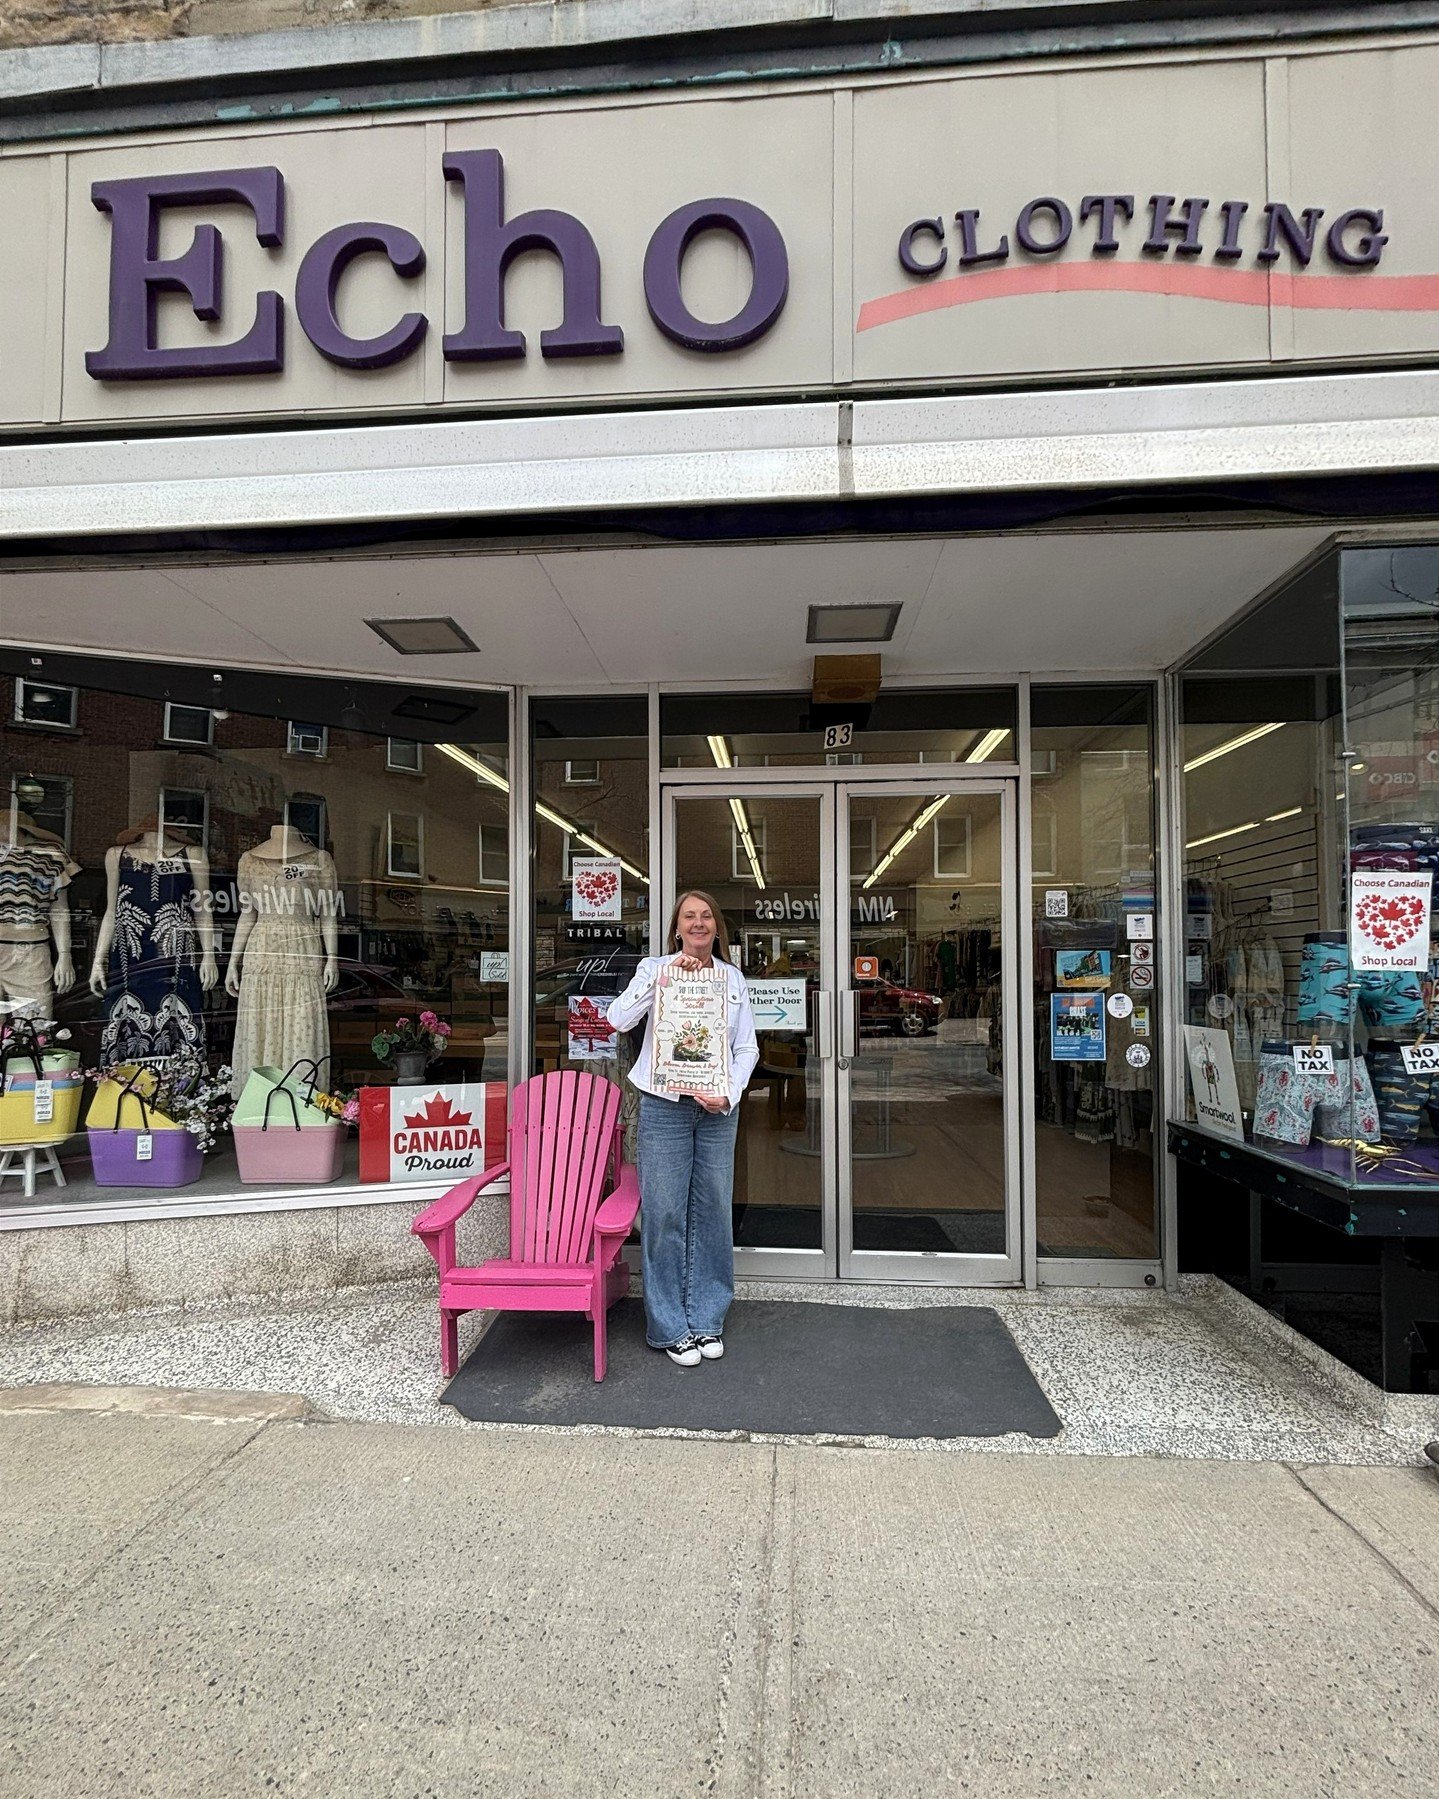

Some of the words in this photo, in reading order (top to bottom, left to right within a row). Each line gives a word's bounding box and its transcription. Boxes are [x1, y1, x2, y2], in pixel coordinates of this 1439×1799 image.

[897, 194, 1390, 277] CLOTHING
[84, 148, 790, 380] Echo
[826, 724, 851, 747] 83
[160, 866, 182, 874] OFF
[285, 870, 305, 880] OFF
[1353, 878, 1386, 888] Choose
[1388, 879, 1430, 888] Canadian
[578, 910, 596, 918] Shop
[567, 928, 623, 938] TRIBAL
[1361, 955, 1388, 967] Shop
[1391, 956, 1417, 966] Local
[575, 946, 621, 991] up!
[747, 987, 779, 996] Please
[781, 986, 800, 995] Use
[749, 996, 775, 1005] ther
[777, 997, 802, 1005] Door
[1301, 1049, 1324, 1060] NO
[1410, 1047, 1434, 1059] NO
[1298, 1060, 1329, 1071] TAX
[1198, 1101, 1237, 1125] Smartwool
[393, 1128, 483, 1154] CANADA
[404, 1152, 475, 1172] Proud
